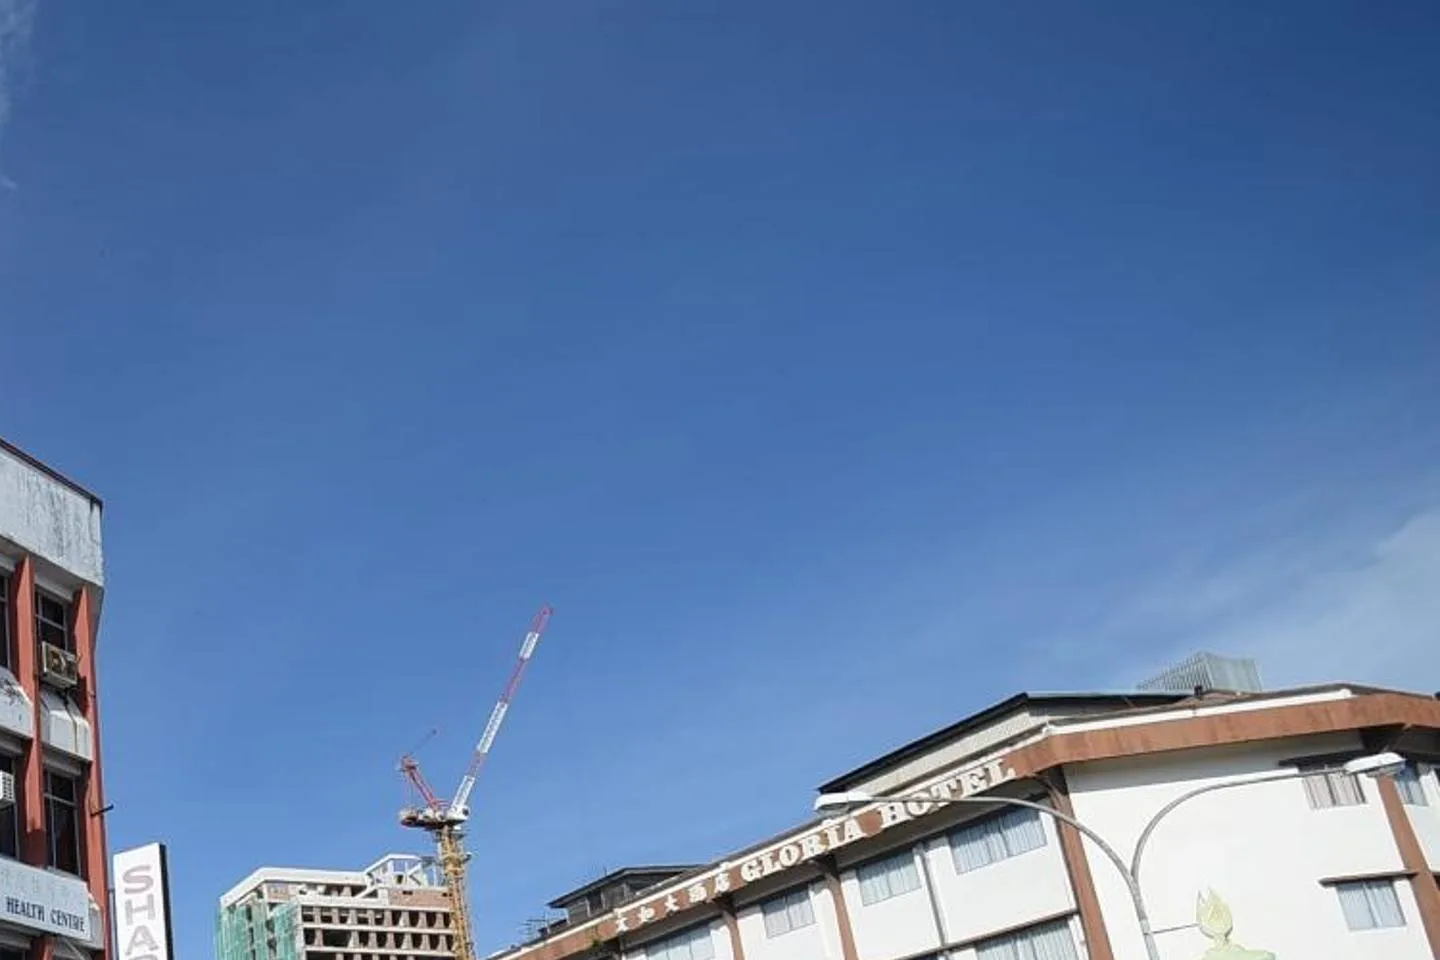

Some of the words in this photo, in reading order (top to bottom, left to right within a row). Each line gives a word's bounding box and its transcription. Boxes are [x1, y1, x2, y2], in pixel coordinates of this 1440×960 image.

[740, 822, 866, 883] GLORIA
[880, 759, 1016, 830] HOTEL
[5, 896, 45, 922] HEALTH
[49, 908, 86, 932] CENTRE
